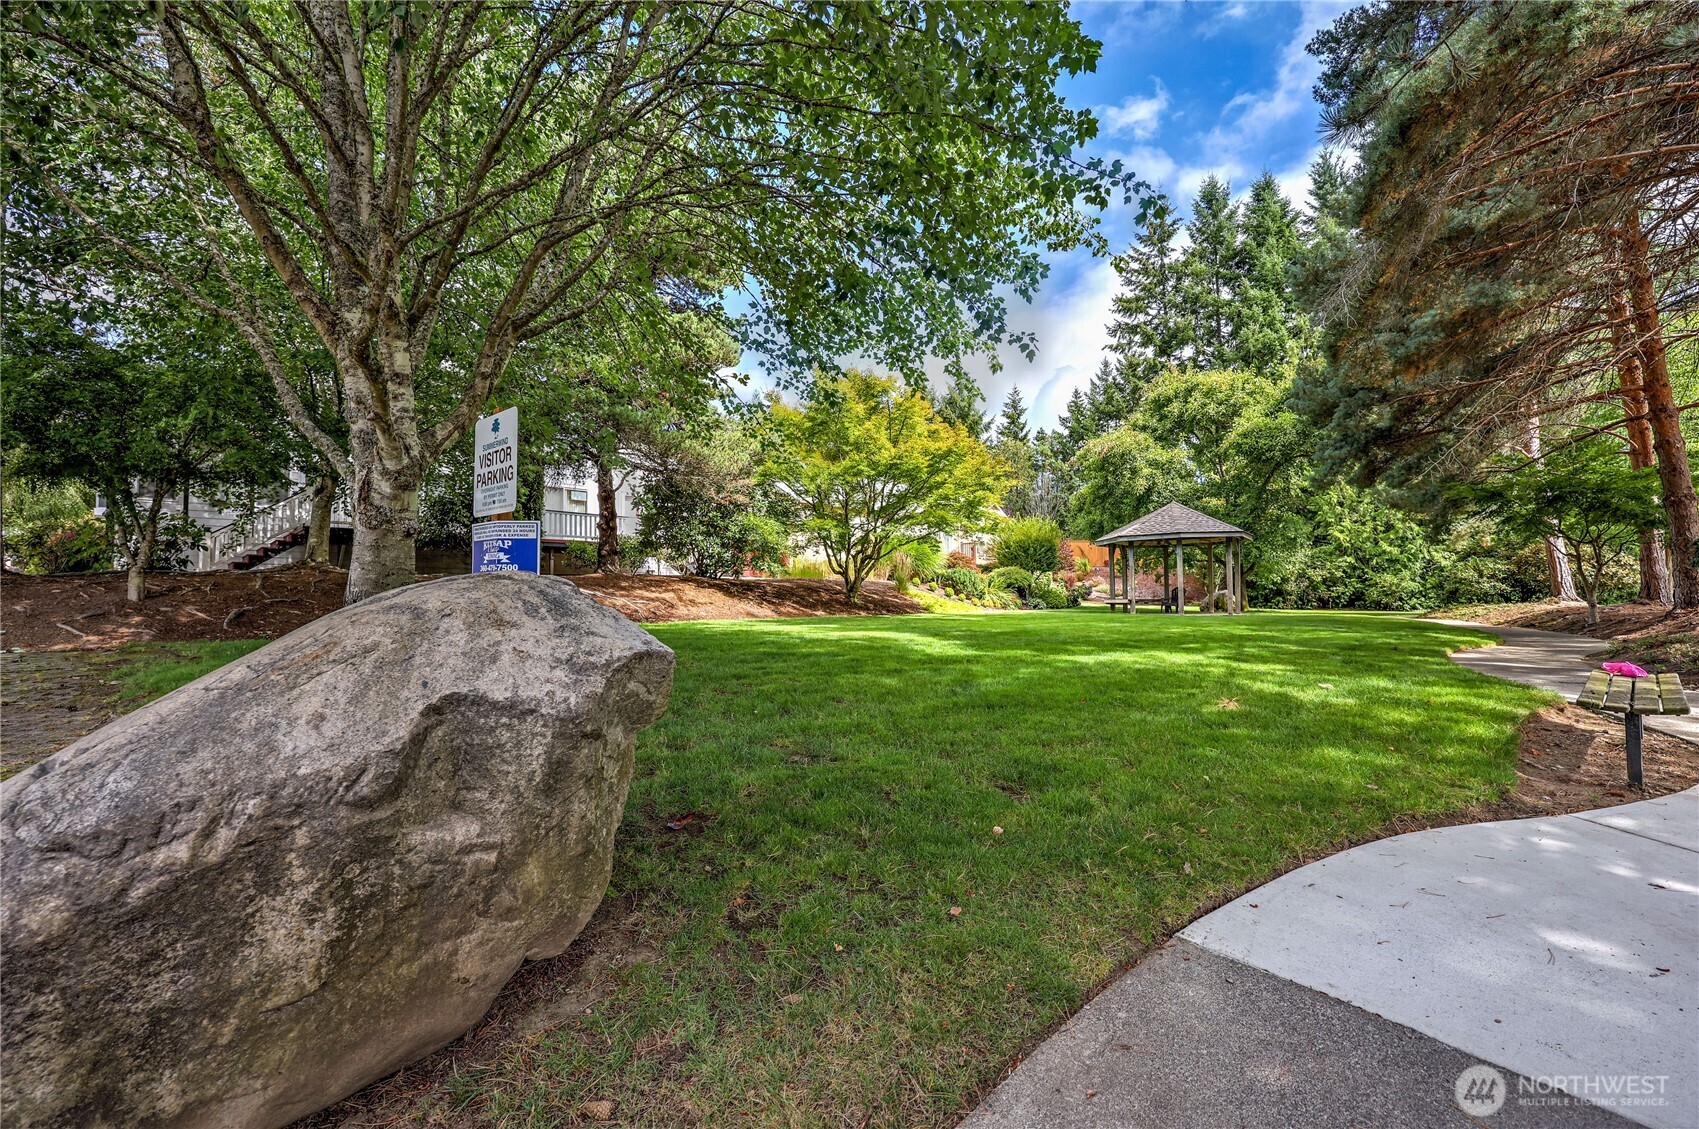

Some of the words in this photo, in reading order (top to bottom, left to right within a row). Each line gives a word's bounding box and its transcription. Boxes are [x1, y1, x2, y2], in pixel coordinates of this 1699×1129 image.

[482, 437, 508, 452] SUMMERWIND
[479, 446, 512, 470] VISITOR
[476, 465, 514, 489] PARKING
